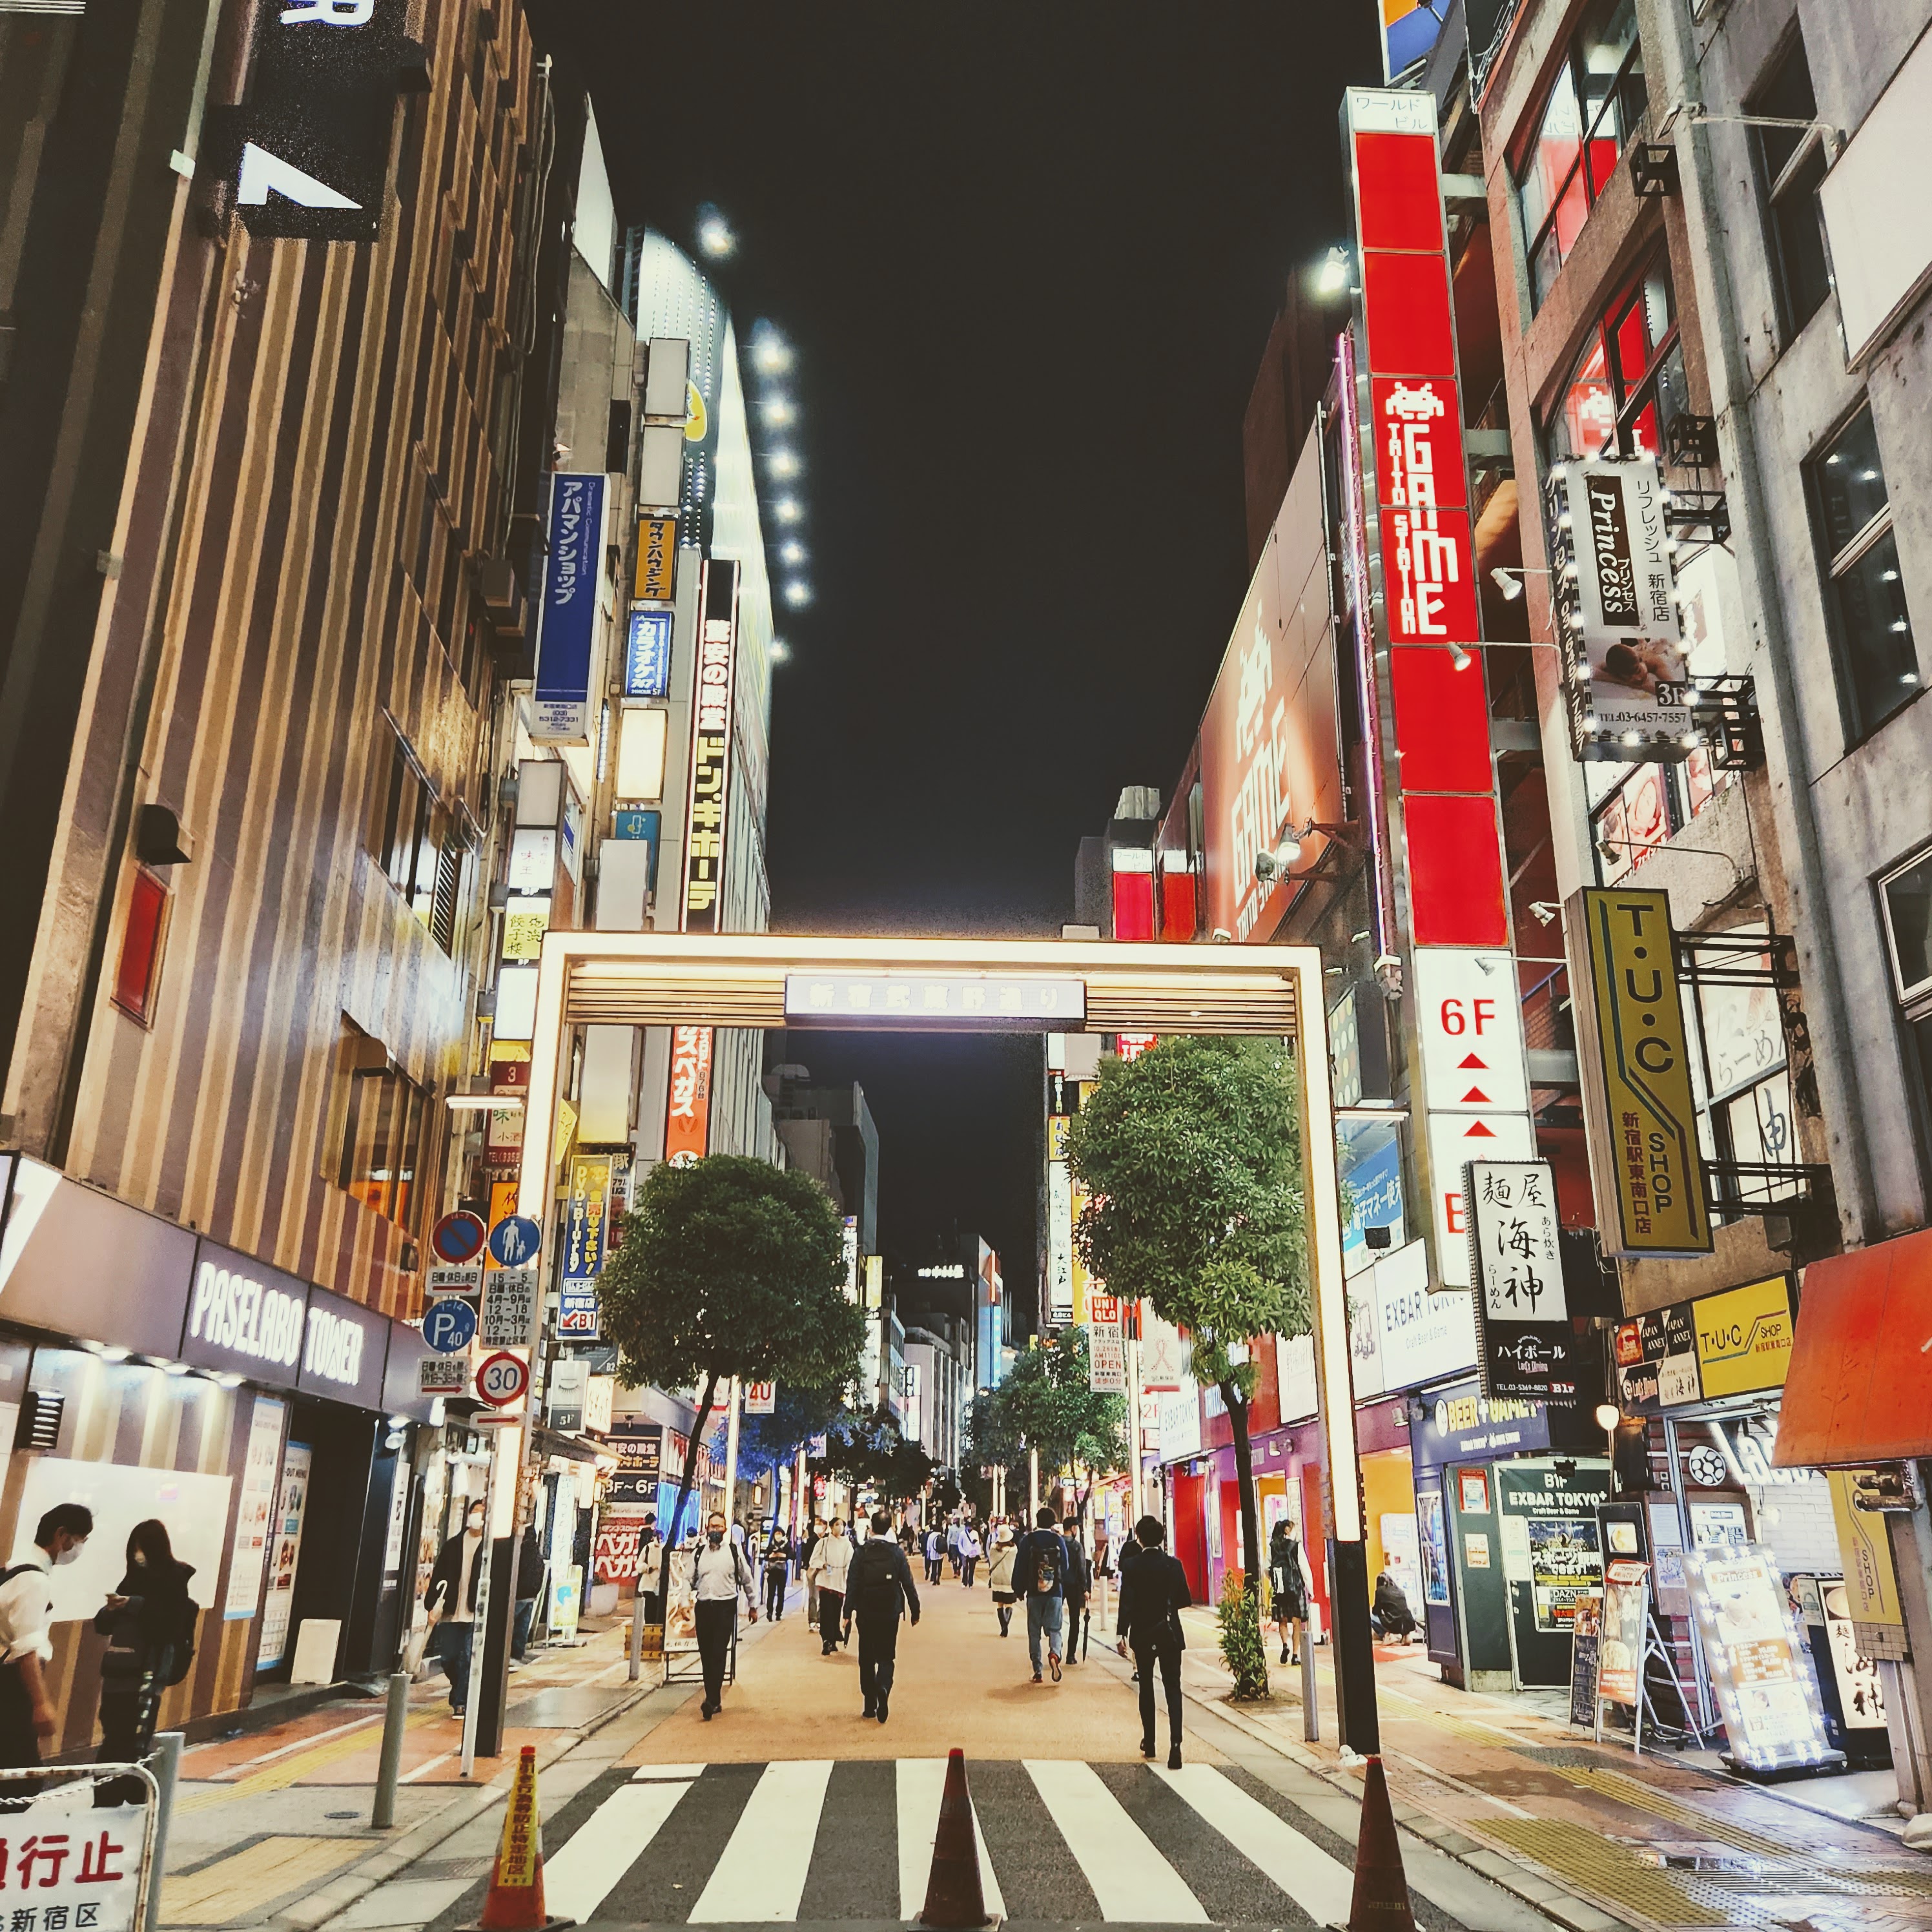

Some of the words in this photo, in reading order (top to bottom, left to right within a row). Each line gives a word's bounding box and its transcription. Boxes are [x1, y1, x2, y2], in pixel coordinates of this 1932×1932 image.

[1357, 98, 1420, 111] ワールド
[1395, 117, 1427, 129] ビル
[1388, 423, 1406, 505] TAITO
[555, 482, 582, 604] アパマンショップ
[1404, 424, 1459, 635] GAME
[1637, 480, 1662, 562] リフレッシュ
[1590, 490, 1623, 613] Princess
[1395, 515, 1416, 634] STATION
[1618, 558, 1636, 611] プリンセス
[1648, 573, 1670, 622] 新宿店
[633, 622, 657, 678] カラオケ
[700, 619, 730, 730] 驚安の殿堂
[1441, 998, 1495, 1036] 6F
[1483, 1171, 1547, 1209] 麺屋
[1621, 1111, 1652, 1235] 新宿駅東南口店
[1649, 1133, 1672, 1214] SHOP
[1541, 1215, 1555, 1260] あら炊き
[1488, 1264, 1501, 1309] らーめん
[1497, 1217, 1544, 1315] 海神
[190, 1261, 305, 1367] PASELABO
[304, 1306, 364, 1386] TOWER
[1094, 1297, 1114, 1310] UNI
[1094, 1310, 1116, 1322] QLO
[1386, 1291, 1423, 1331] EXBAR
[433, 1313, 455, 1346] P
[1093, 1326, 1119, 1339] 新宿
[1497, 1344, 1566, 1359] ハイボール
[1761, 1324, 1782, 1339] SHOP
[488, 1366, 518, 1391] 30
[1094, 1360, 1121, 1369] OPEN
[1508, 1491, 1555, 1506] EXBAR
[1552, 1588, 1576, 1599] DAZN
[1862, 1549, 1875, 1599] SHOP
